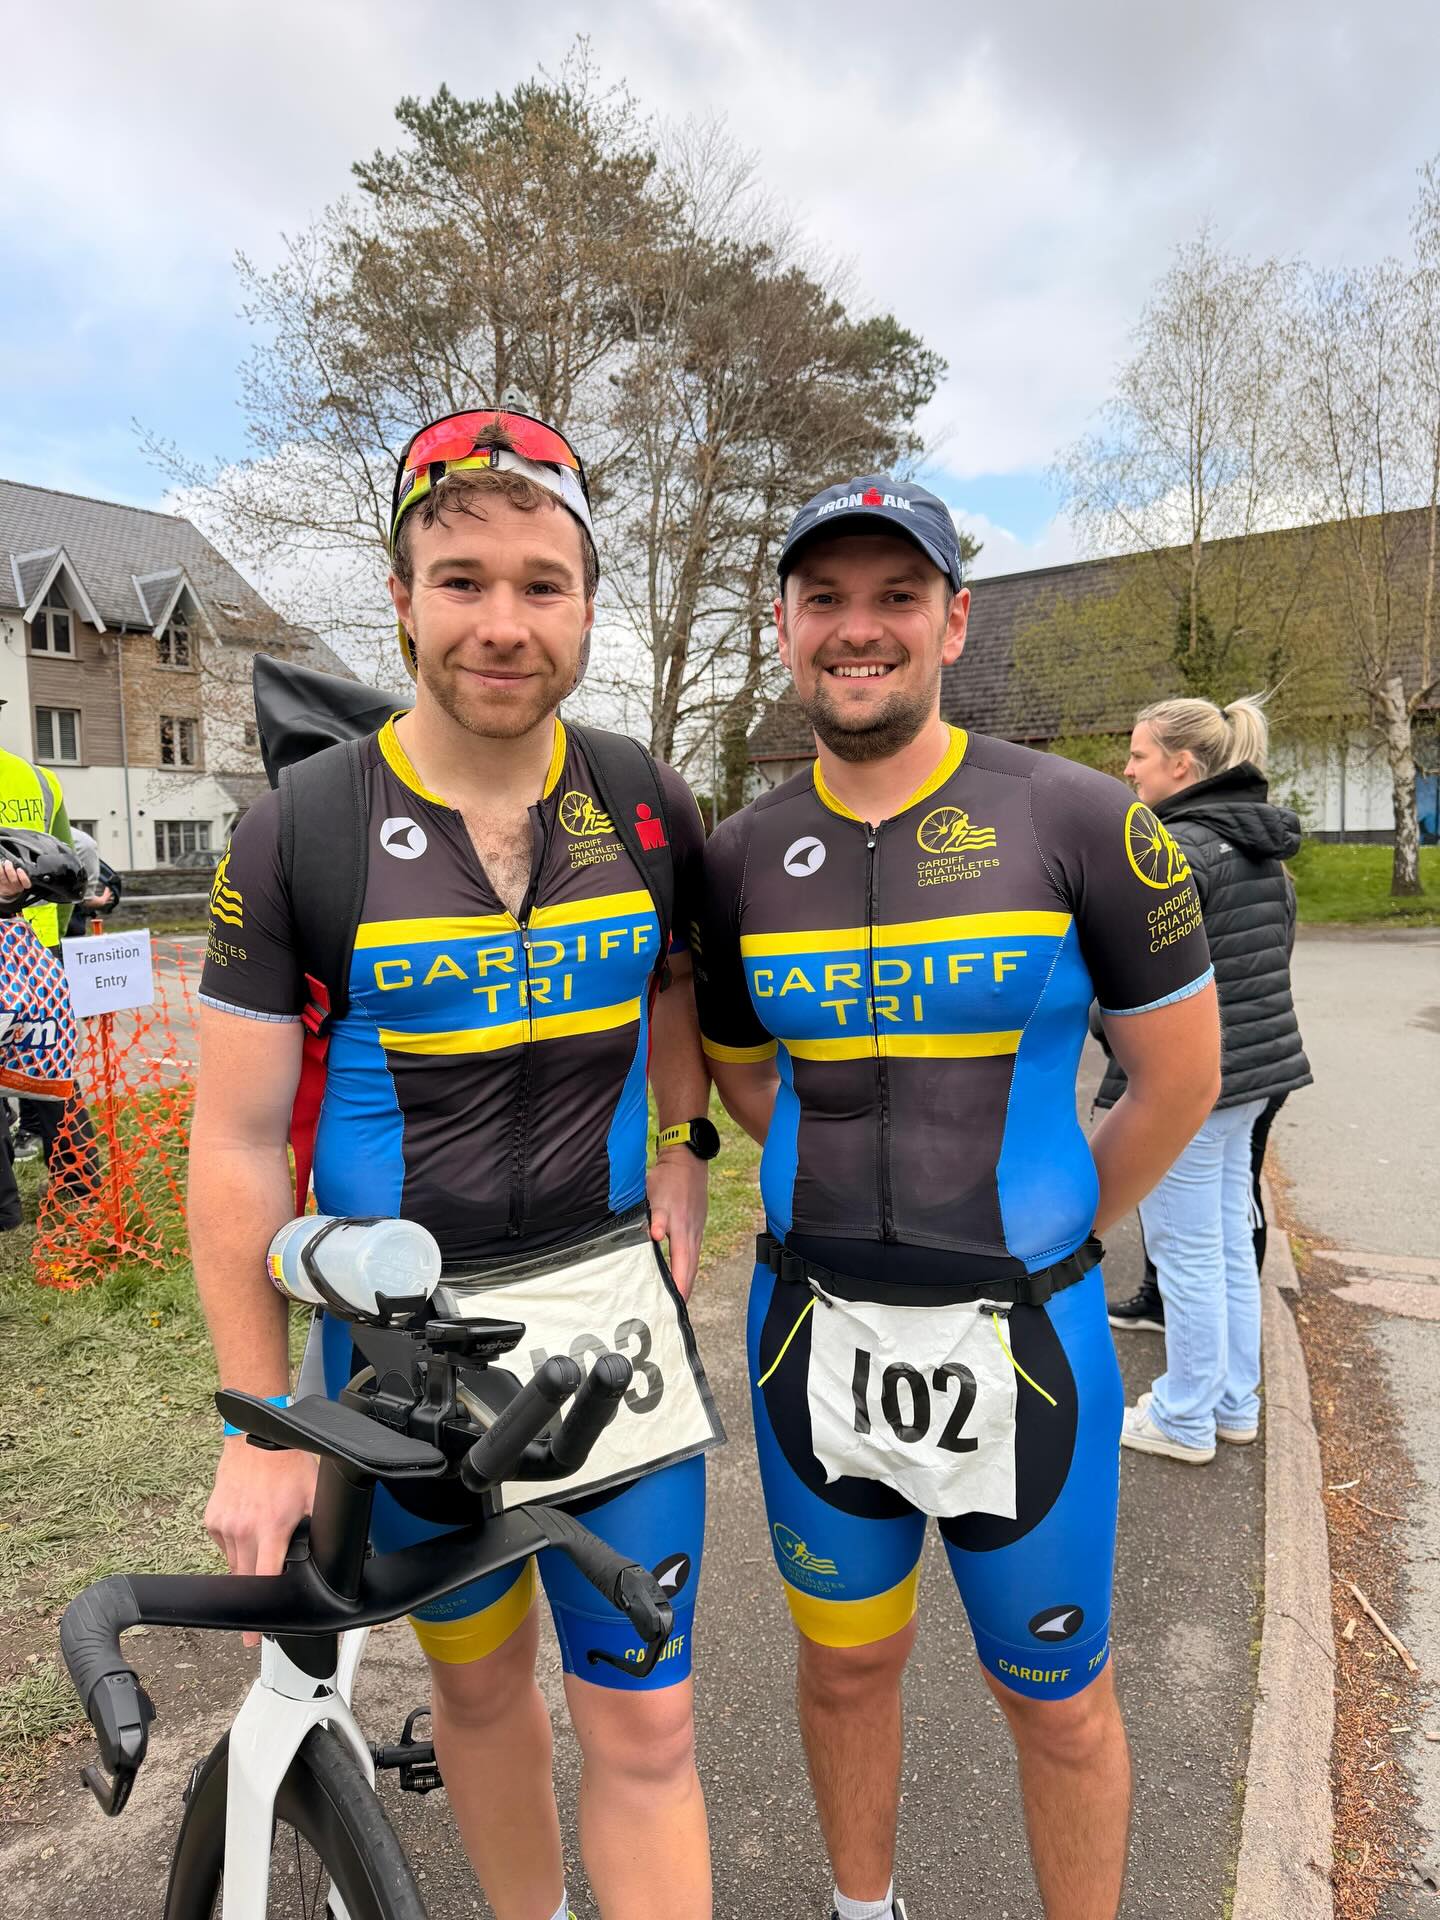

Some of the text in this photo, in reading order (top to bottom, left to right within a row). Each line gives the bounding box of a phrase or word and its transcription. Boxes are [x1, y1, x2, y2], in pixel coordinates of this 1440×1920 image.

[568, 838, 602, 852] CARDIFF
[570, 853, 618, 869] CAERDYDD
[917, 855, 965, 870] CARDIFF
[917, 859, 1000, 879] TRIATHLETES
[917, 870, 981, 887] CAERDYDD
[1147, 886, 1192, 924] CARDIFF
[76, 946, 140, 966] Transition
[373, 924, 653, 991] CARDIFF
[95, 974, 128, 989] Entry
[753, 950, 1028, 998] CARDIFF
[472, 973, 573, 1013] TRI
[820, 994, 924, 1026] TRI
[852, 1347, 978, 1453] 102
[998, 1658, 1071, 1683] CARDIFF
